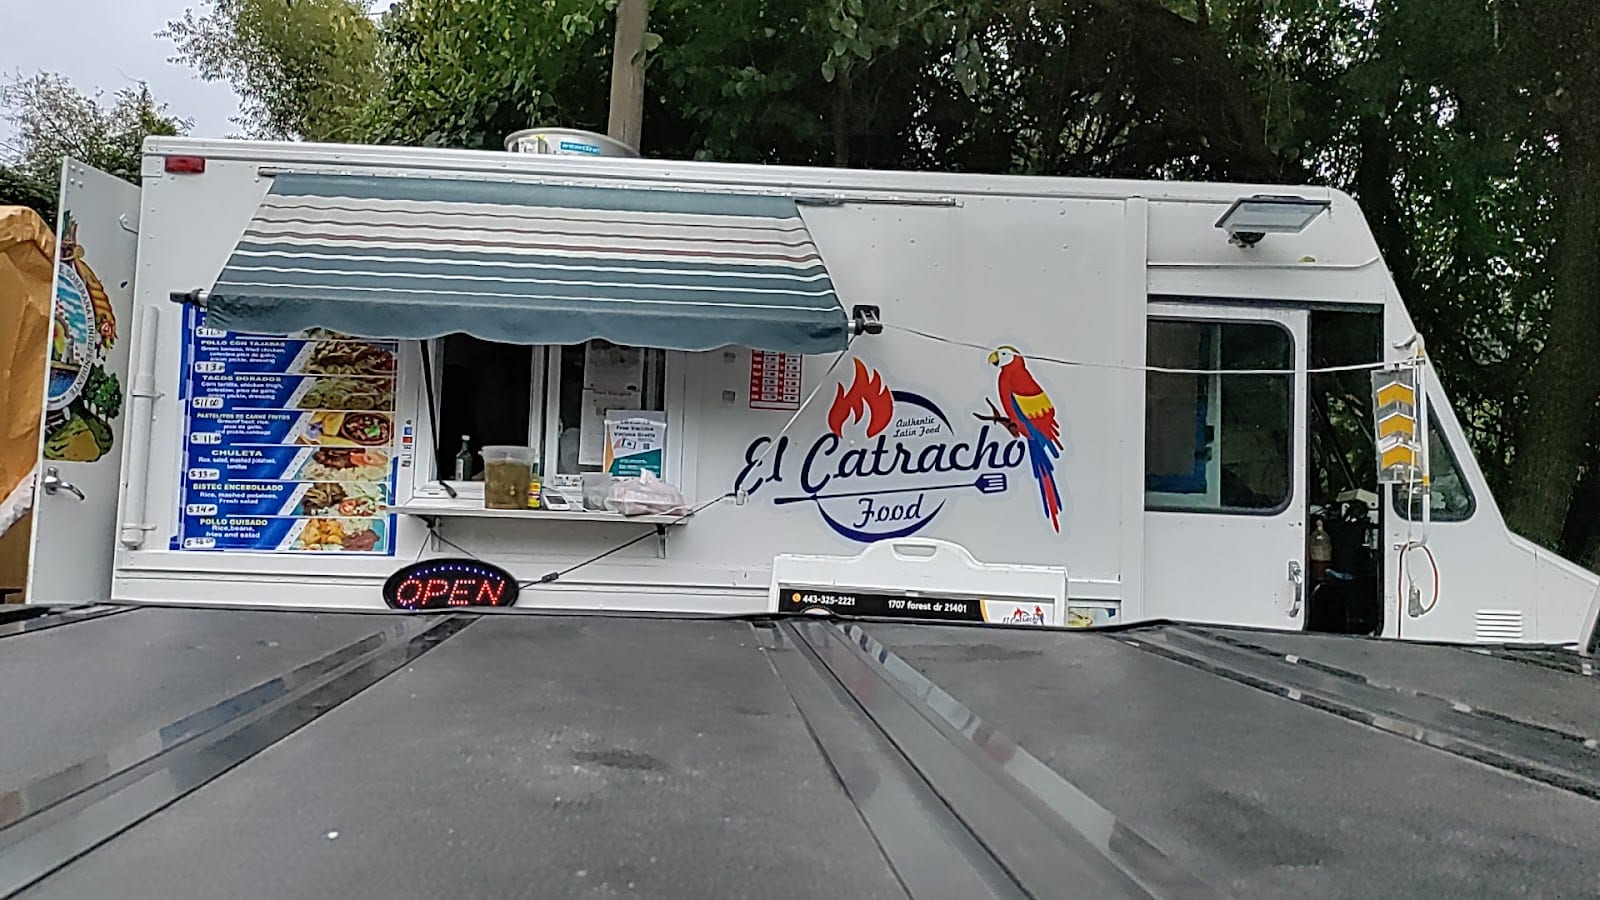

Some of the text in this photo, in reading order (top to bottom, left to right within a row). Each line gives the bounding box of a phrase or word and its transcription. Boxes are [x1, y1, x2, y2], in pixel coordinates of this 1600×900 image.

[895, 415, 935, 427] Authentic
[892, 423, 941, 438] Latin Food
[734, 424, 1026, 496] El Catracho
[853, 493, 925, 529] Food
[396, 578, 506, 606] OPEN
[802, 594, 856, 606] 443-325-2221
[888, 599, 967, 613] 1707 forest dr 21401
